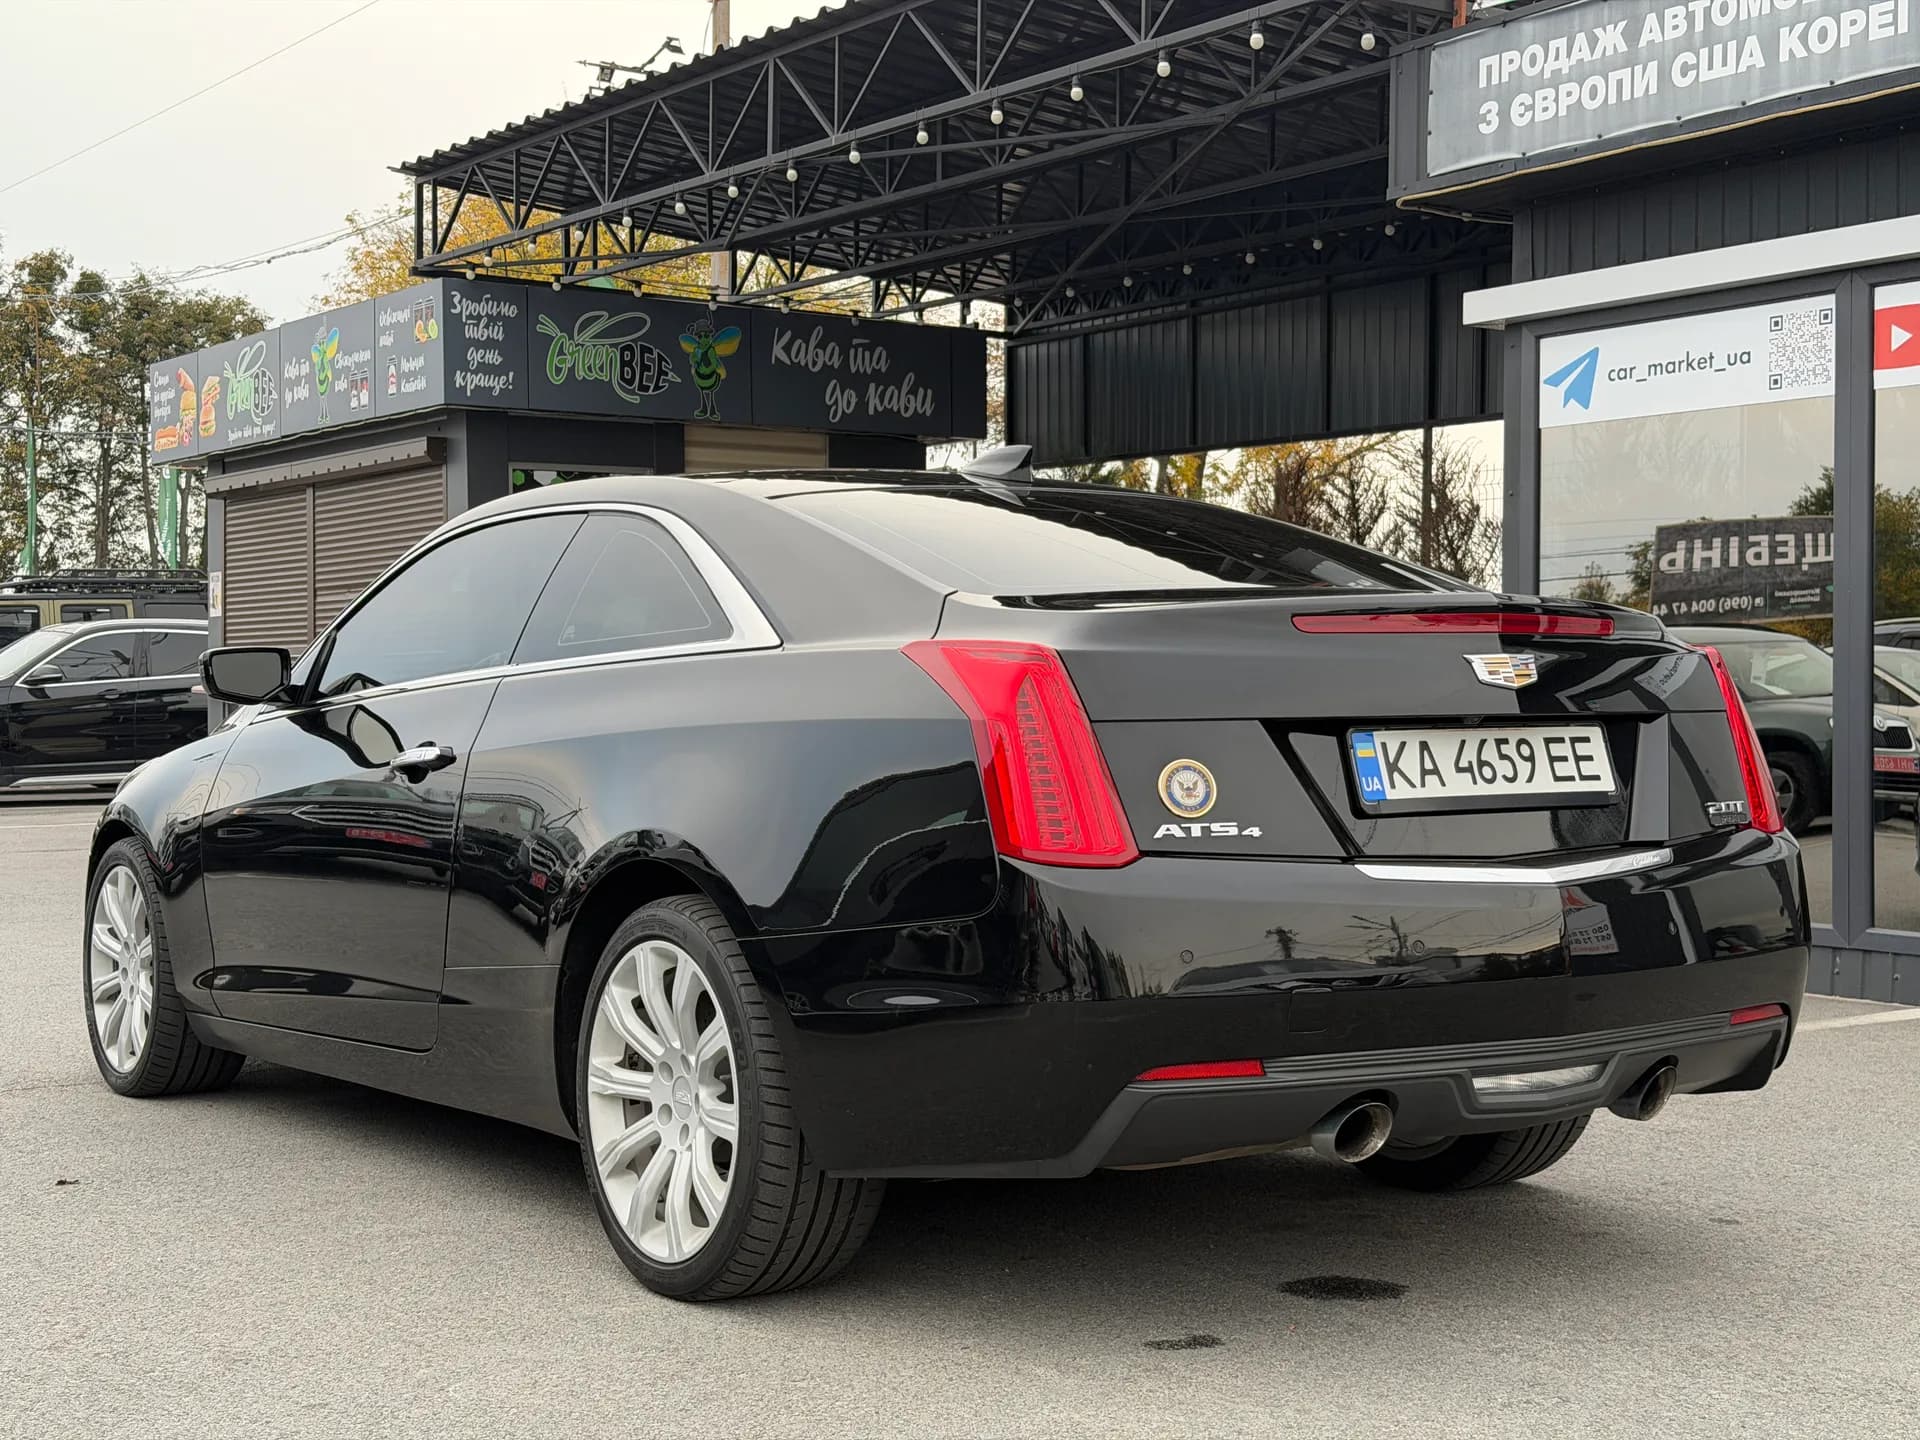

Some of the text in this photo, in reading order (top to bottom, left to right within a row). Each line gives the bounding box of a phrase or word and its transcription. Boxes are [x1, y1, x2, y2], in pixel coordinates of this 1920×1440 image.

[1478, 0, 1816, 89] ПРОДАЖ АВТОМ
[1478, 101, 1499, 135] З
[1510, 60, 1658, 127] ЄВРОПИ
[1671, 34, 1765, 87] США
[450, 291, 519, 322] Зробимо
[464, 317, 505, 342] твій
[466, 346, 503, 370] день
[771, 325, 890, 375] Кава та
[1607, 350, 1751, 382] car_market_ua
[454, 370, 514, 397] краще!
[825, 372, 935, 423] до кави
[1453, 737, 1536, 785] 4659
[1542, 735, 1602, 782] EE
[1363, 776, 1383, 793] UA
